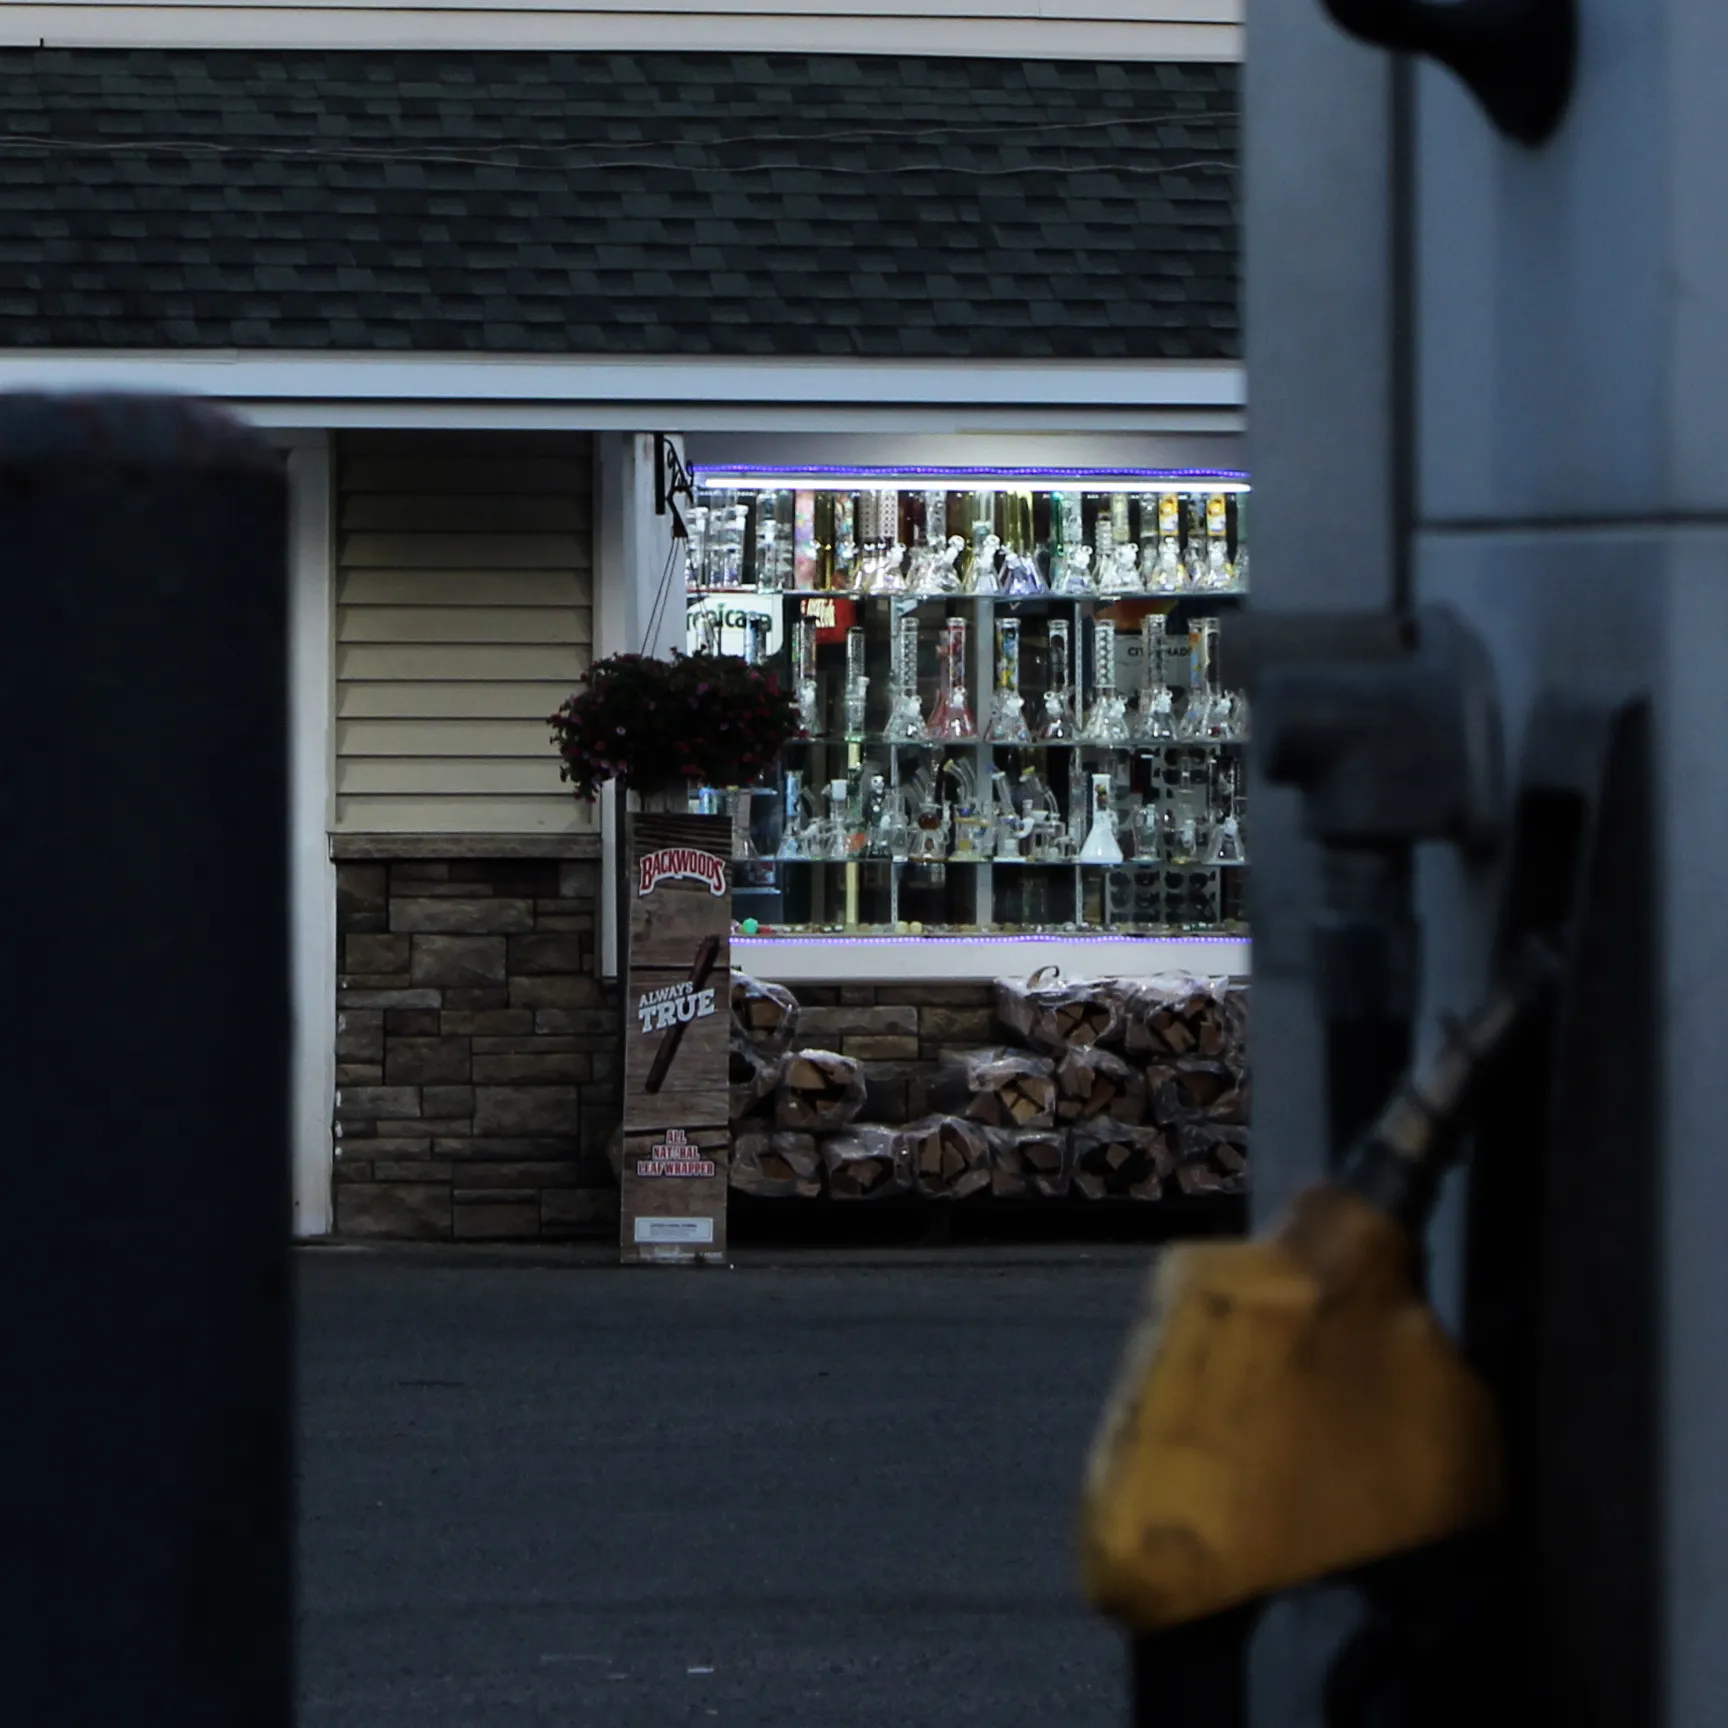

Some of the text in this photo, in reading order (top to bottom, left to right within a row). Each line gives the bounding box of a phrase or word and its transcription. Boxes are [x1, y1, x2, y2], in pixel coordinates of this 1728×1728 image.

[639, 849, 726, 896] BACKWOODS
[639, 982, 694, 1007] ALWAYS
[638, 988, 715, 1034] TRUE
[666, 1129, 687, 1144] ALL
[665, 1161, 715, 1176] WRAPPER
